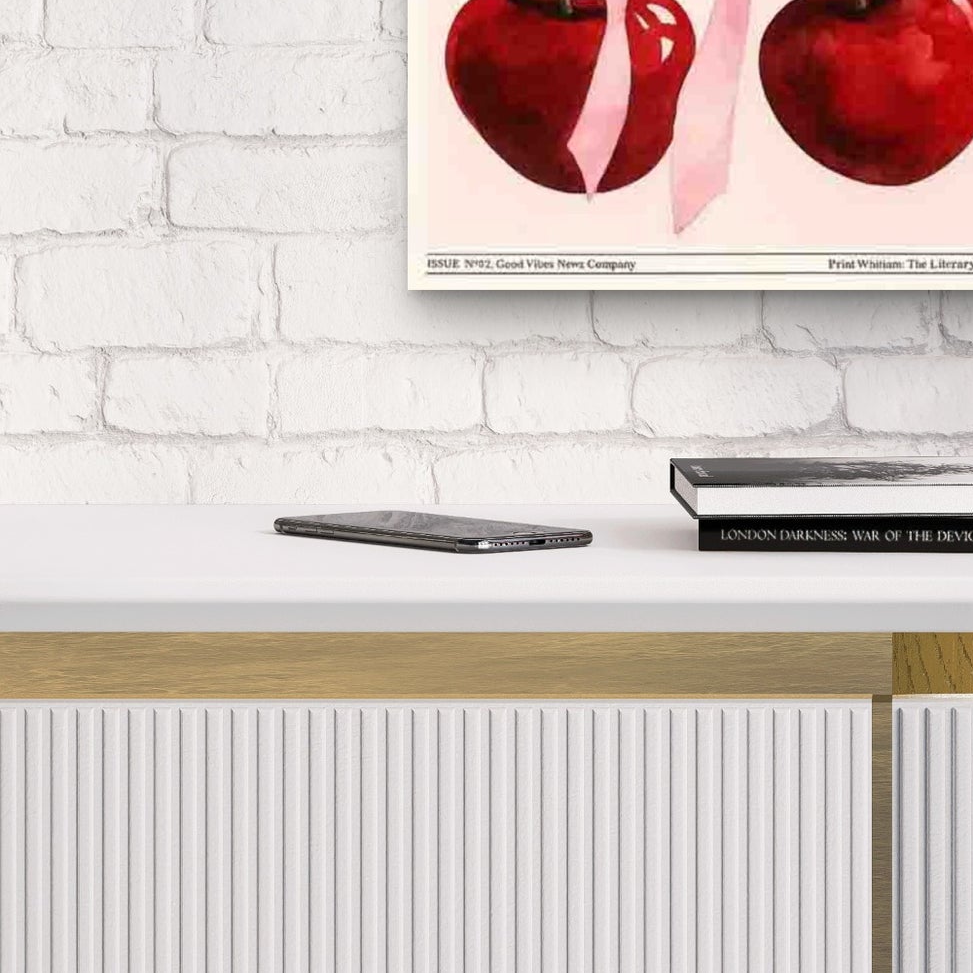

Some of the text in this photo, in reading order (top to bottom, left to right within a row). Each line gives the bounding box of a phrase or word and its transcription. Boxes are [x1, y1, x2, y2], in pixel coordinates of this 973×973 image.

[427, 258, 460, 269] ISSUE
[496, 258, 524, 269] Good
[526, 258, 555, 269] Vibes
[586, 258, 637, 272] Company
[828, 258, 855, 270] Print
[906, 258, 927, 270] The
[721, 529, 777, 541] LONDON
[780, 529, 848, 542] DARKNESS:
[851, 529, 880, 542] WAR
[884, 529, 901, 542] OF
[907, 530, 933, 542] THE
